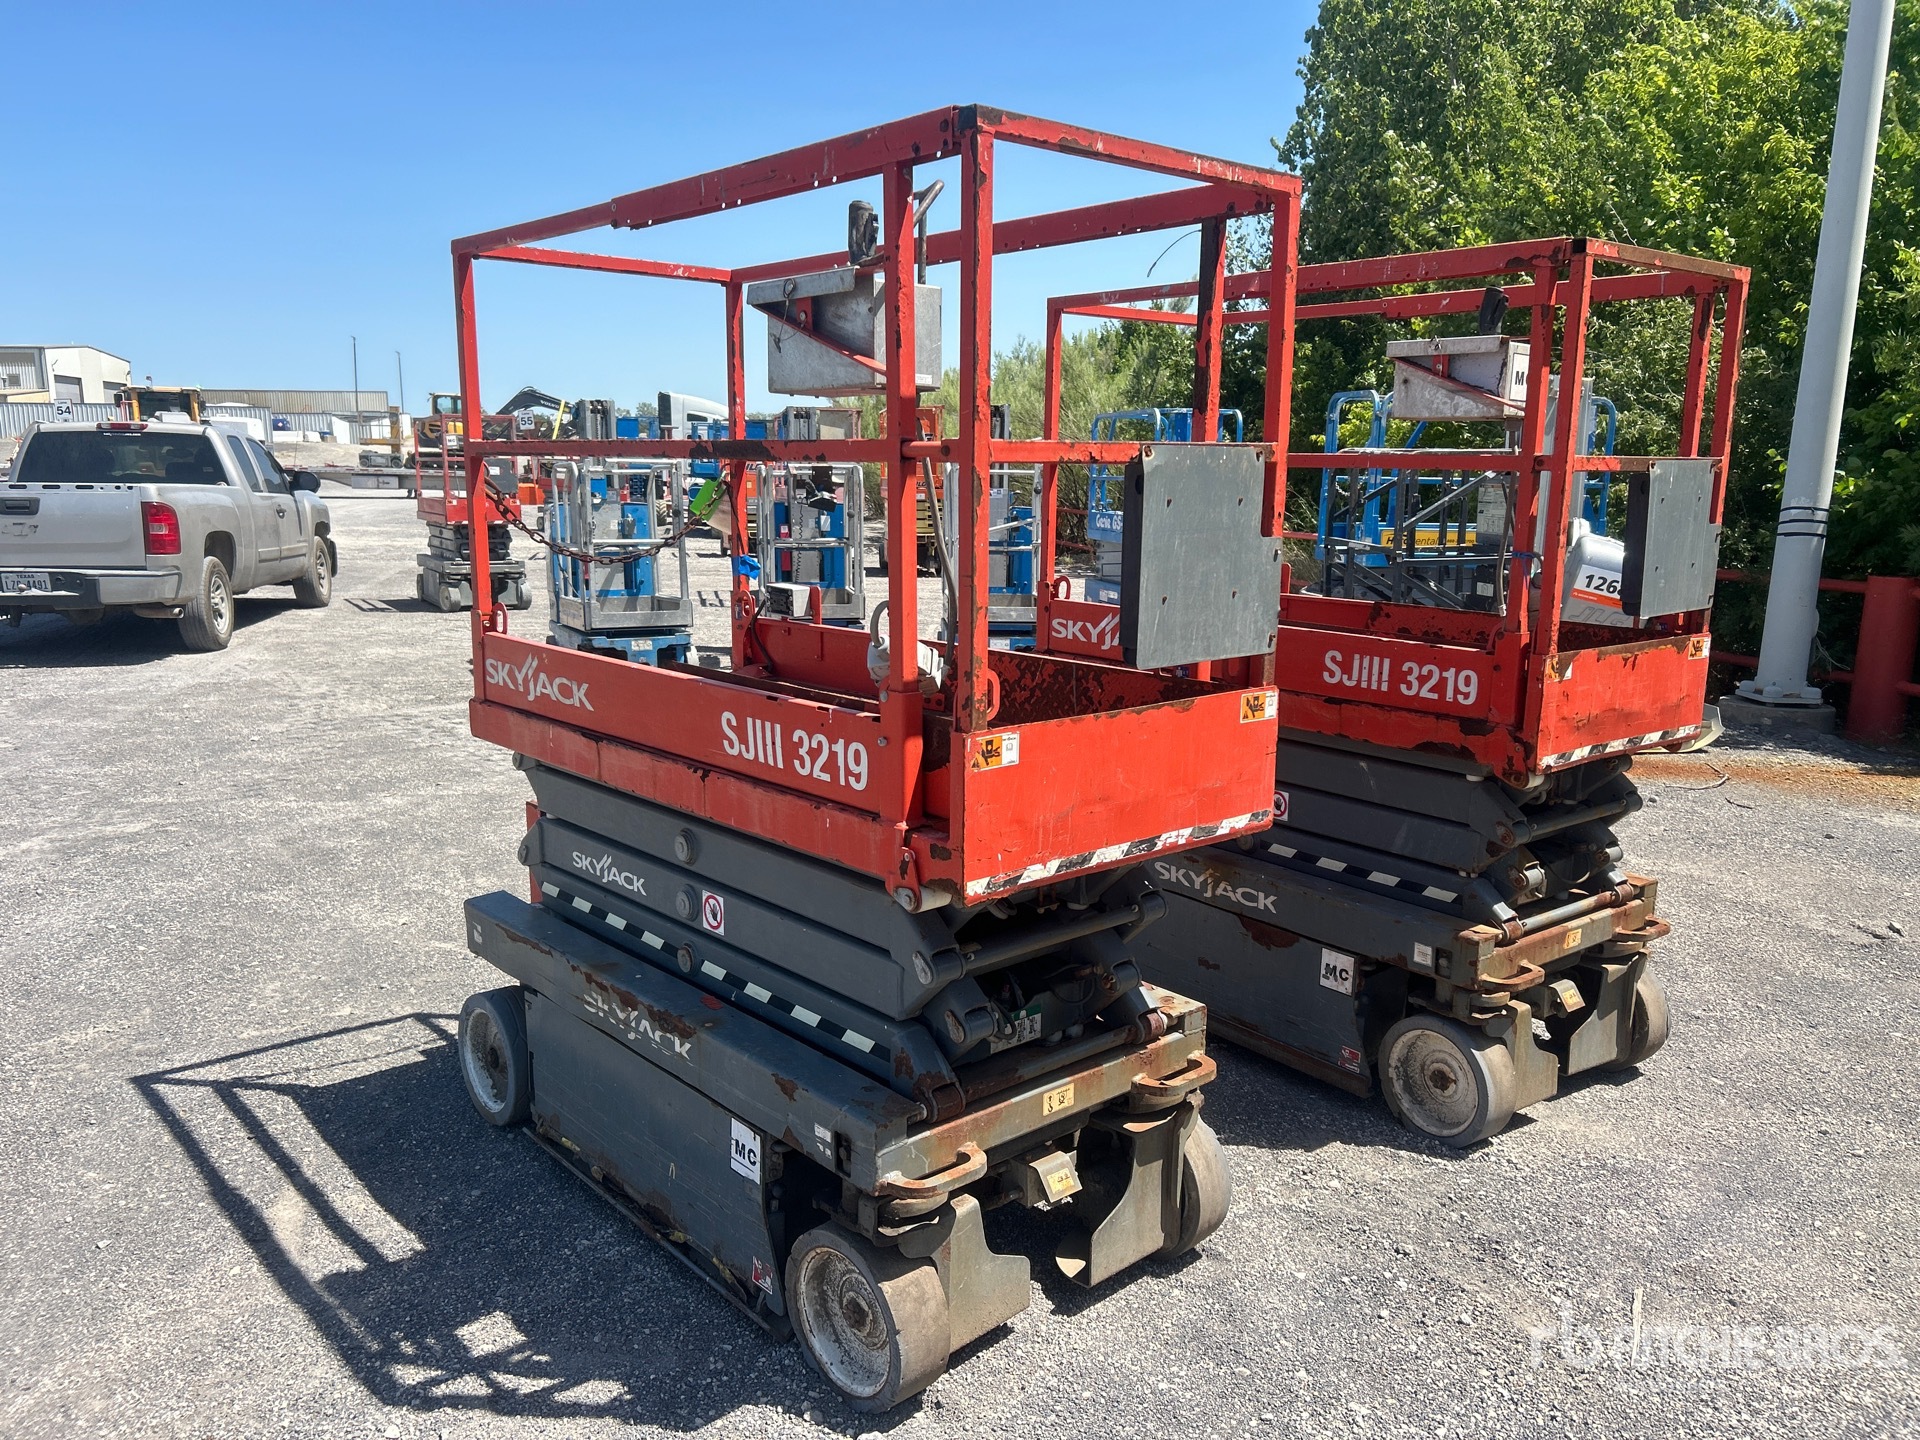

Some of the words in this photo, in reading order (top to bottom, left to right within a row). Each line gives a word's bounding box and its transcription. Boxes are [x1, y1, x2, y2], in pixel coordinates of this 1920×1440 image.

[56, 406, 72, 416] 54
[540, 400, 560, 409] VOLVO
[520, 416, 533, 426] 55
[1095, 514, 1111, 529] Genie
[485, 652, 595, 712] SKYJACK
[1323, 650, 1390, 692] SJIII
[1400, 661, 1478, 705] 3219
[721, 711, 784, 769] SJIII
[792, 729, 869, 791] 3219
[572, 851, 647, 896] SKYJACK
[1154, 861, 1278, 914] SKYJACK
[1324, 963, 1350, 982] MC
[734, 1138, 757, 1167] MC
